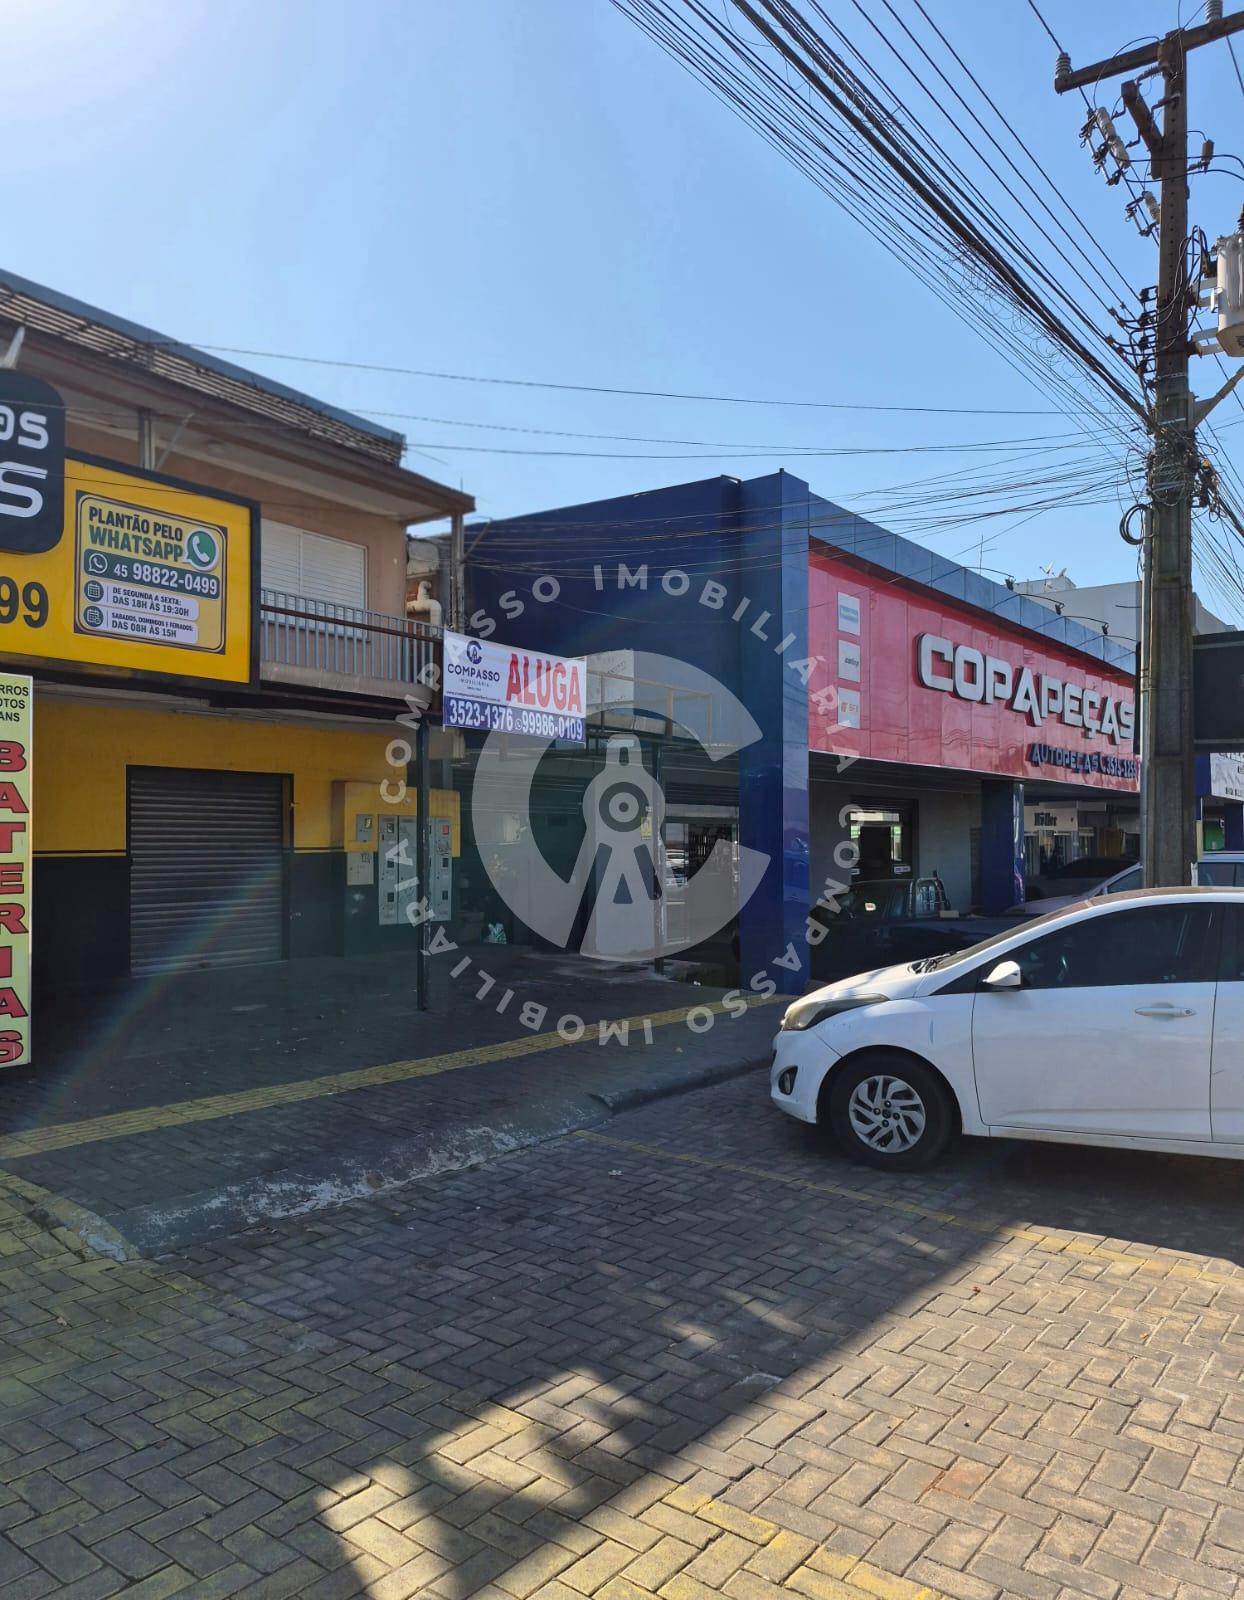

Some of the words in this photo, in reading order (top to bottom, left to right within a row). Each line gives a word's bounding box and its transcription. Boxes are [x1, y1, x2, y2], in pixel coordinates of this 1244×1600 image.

[89, 506, 150, 534] PLANTÃO
[153, 521, 183, 541] PELO
[89, 524, 184, 562] WHATSAPP
[112, 586, 121, 595] DE
[122, 589, 153, 600] SEGUNDA
[113, 563, 128, 577] 45
[132, 562, 218, 595] 98822-0499
[112, 595, 130, 606] DAS
[131, 598, 147, 609] 18H
[162, 604, 190, 617] 19:30H
[111, 620, 129, 631] DAS
[130, 623, 147, 633] 08H
[162, 628, 177, 638] 15H
[447, 663, 501, 682] COMPASSO
[505, 652, 582, 713] ALUGA
[919, 632, 1135, 745] COPAPEÇAS
[0, 684, 29, 696] RROS
[449, 699, 514, 731] 3523-1376
[521, 711, 583, 740] 99986-0109
[1030, 743, 1099, 774] AUTOPEÇAS
